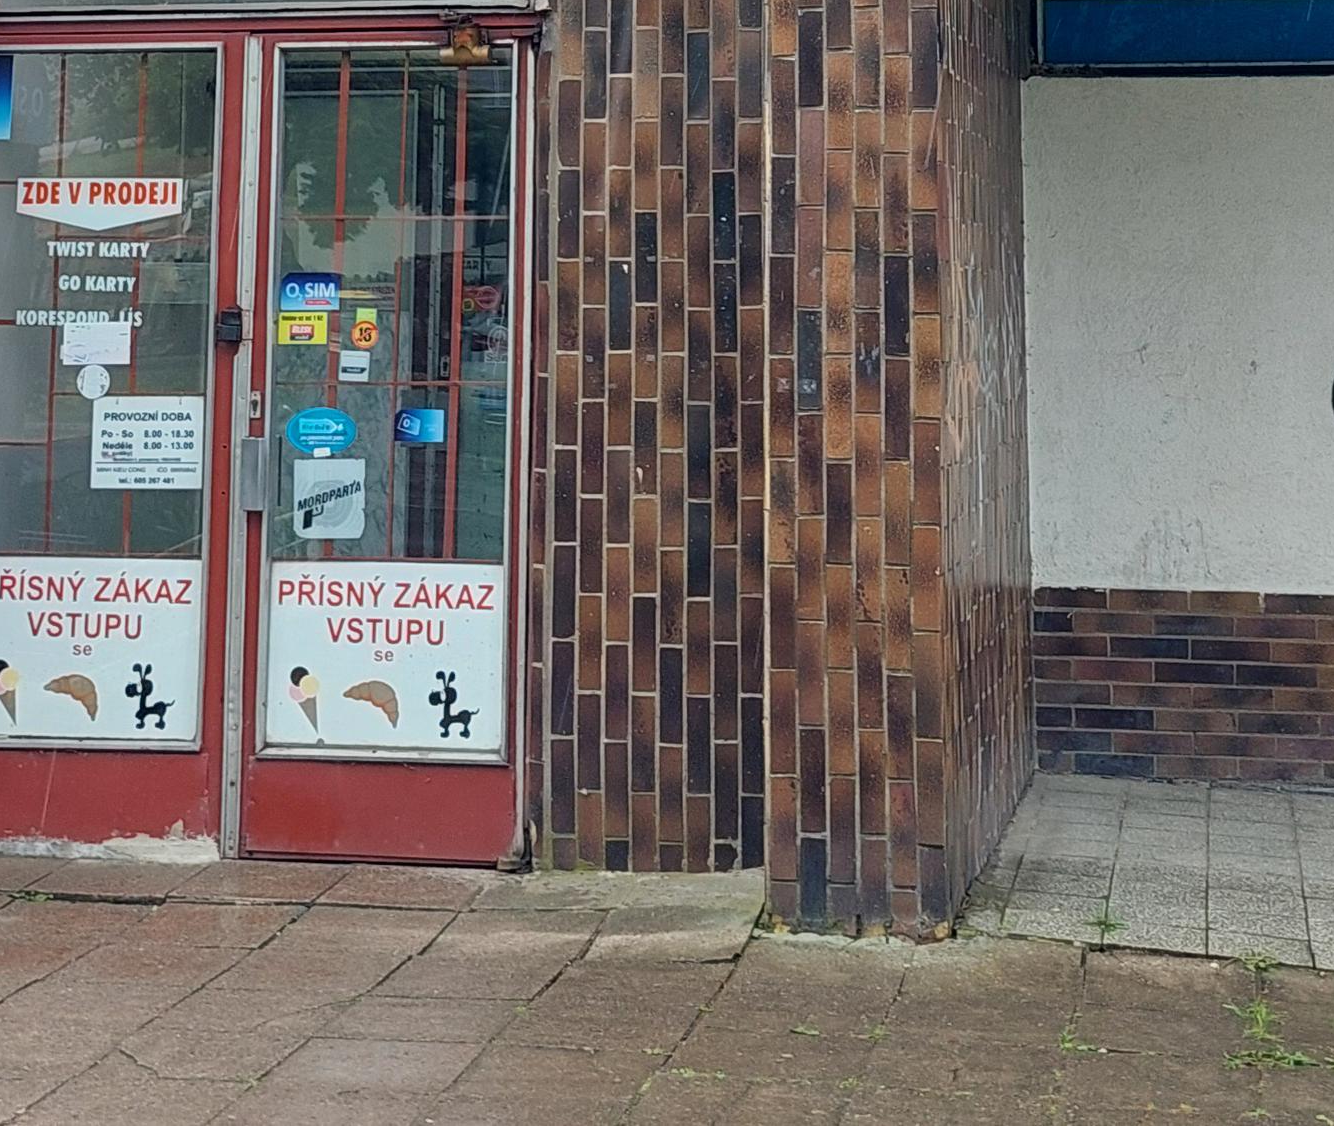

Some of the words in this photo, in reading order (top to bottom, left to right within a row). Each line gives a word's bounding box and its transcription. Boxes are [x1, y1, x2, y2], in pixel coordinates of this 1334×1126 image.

[22, 181, 60, 205] ZDE
[68, 181, 82, 205] V
[89, 181, 178, 205] PRODEJI
[47, 241, 94, 258] TWIST
[99, 242, 150, 259] KARTY
[59, 275, 81, 291] GO
[85, 275, 136, 292] KARTY
[304, 282, 336, 298] SIM
[103, 410, 159, 422] PROVOZNÍ
[161, 412, 193, 422] DOBA
[101, 429, 114, 438] Po
[121, 429, 134, 438] So
[171, 429, 195, 438] 18.30
[143, 441, 162, 450] 8.00
[170, 441, 194, 450] 13.00
[93, 571, 193, 604] ZÁKAZ
[278, 574, 386, 608] PŘÍSNÝ
[393, 576, 495, 610] ZÁKAZ
[27, 611, 142, 640] VSTUPU
[326, 617, 444, 645] VSTUPU
[72, 644, 92, 656] se
[373, 649, 394, 662] se
